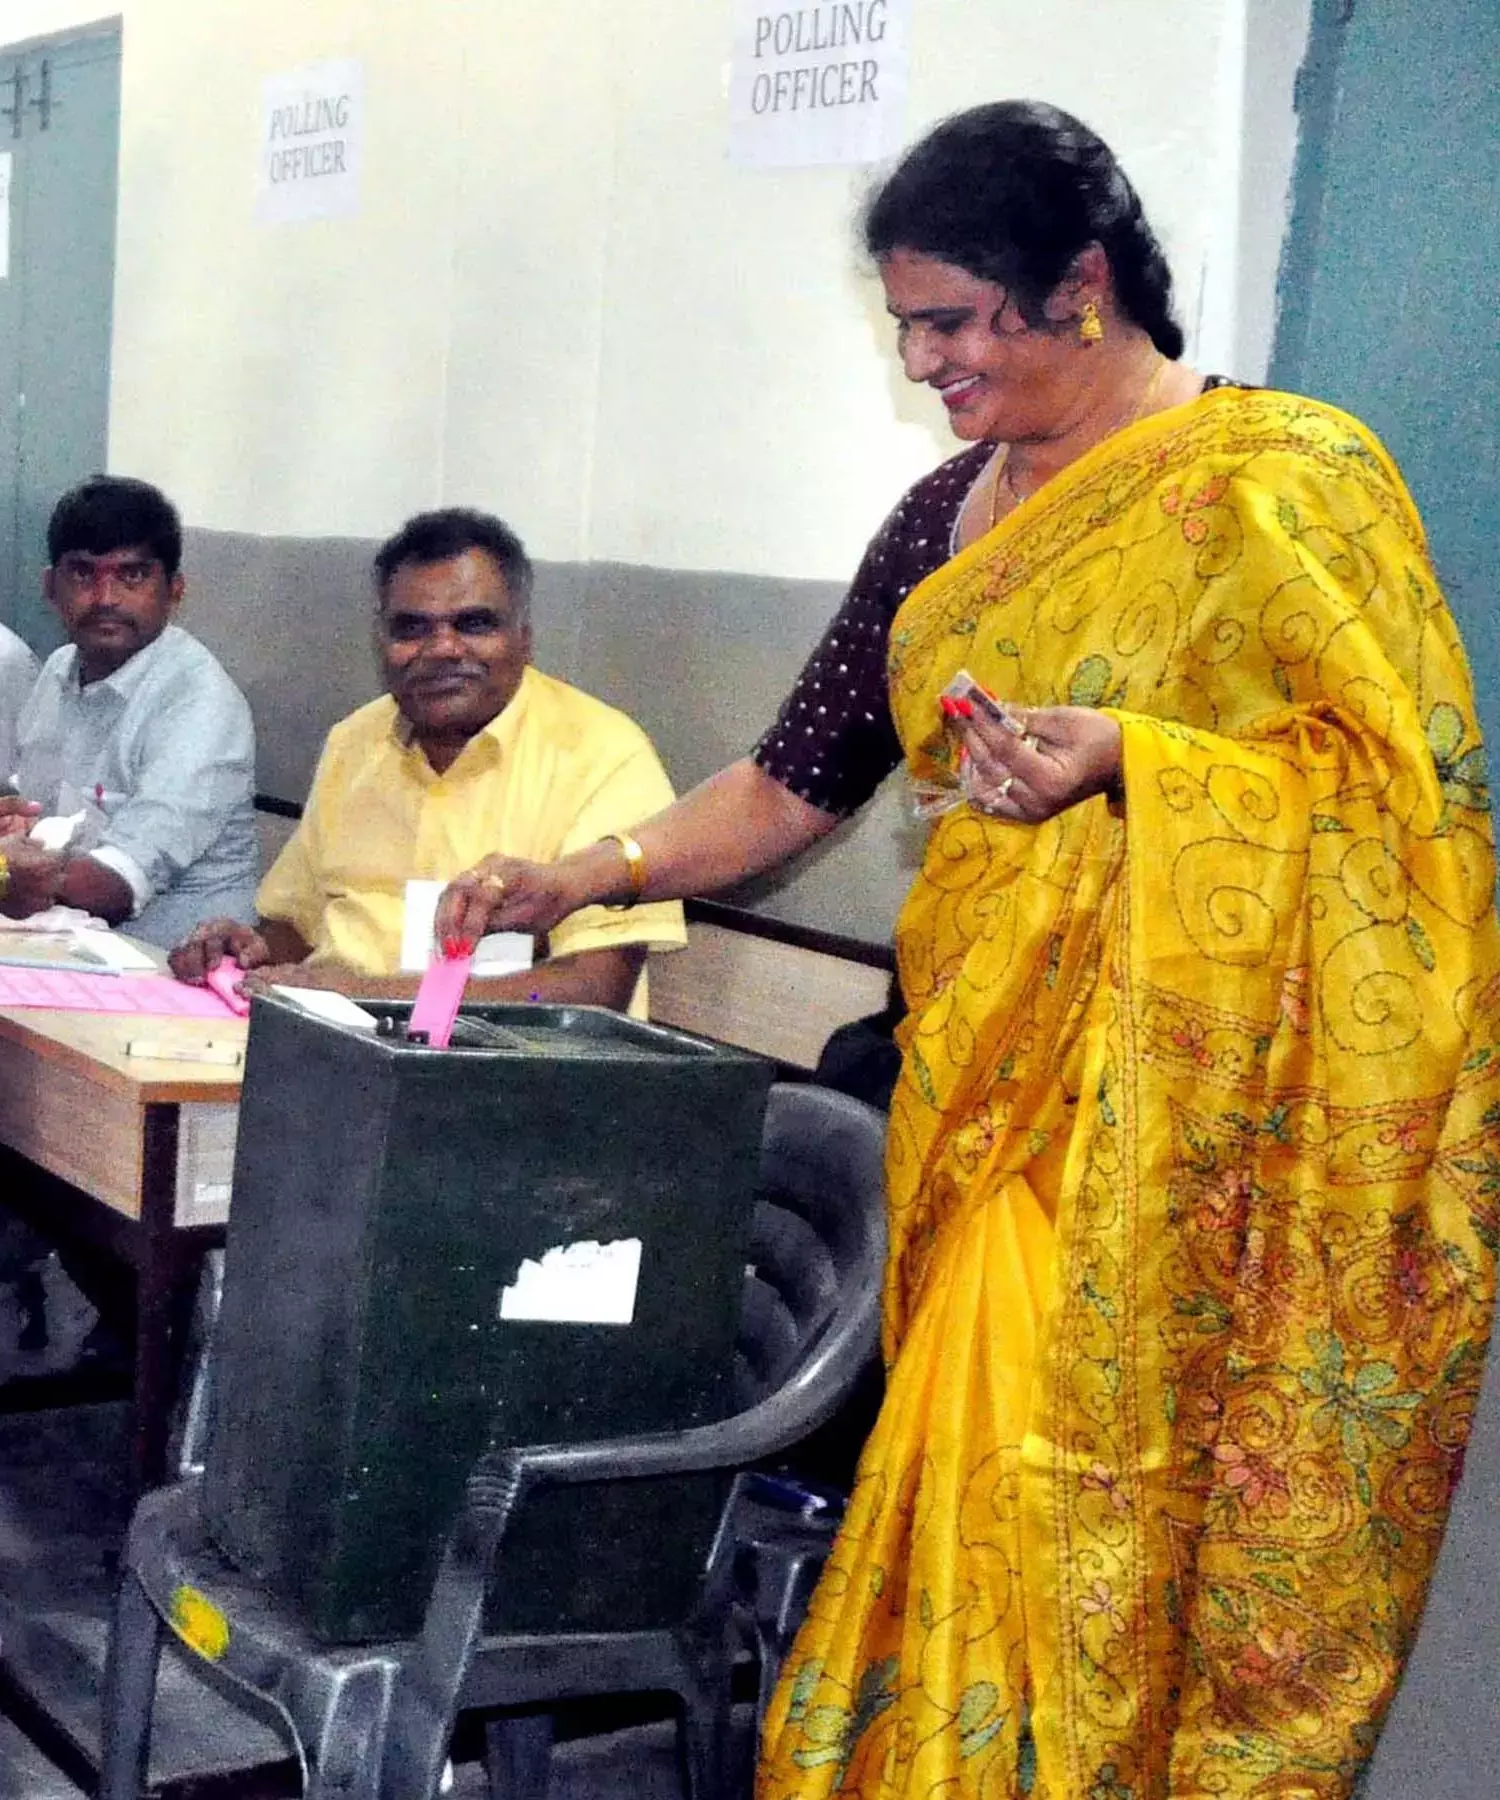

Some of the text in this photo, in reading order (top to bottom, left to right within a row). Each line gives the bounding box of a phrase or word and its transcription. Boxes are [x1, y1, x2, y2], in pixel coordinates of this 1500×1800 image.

[754, 0, 887, 59] POLLING
[751, 60, 880, 115] OFFICER
[269, 94, 350, 141] POLLING
[269, 140, 348, 184] OFFICER
